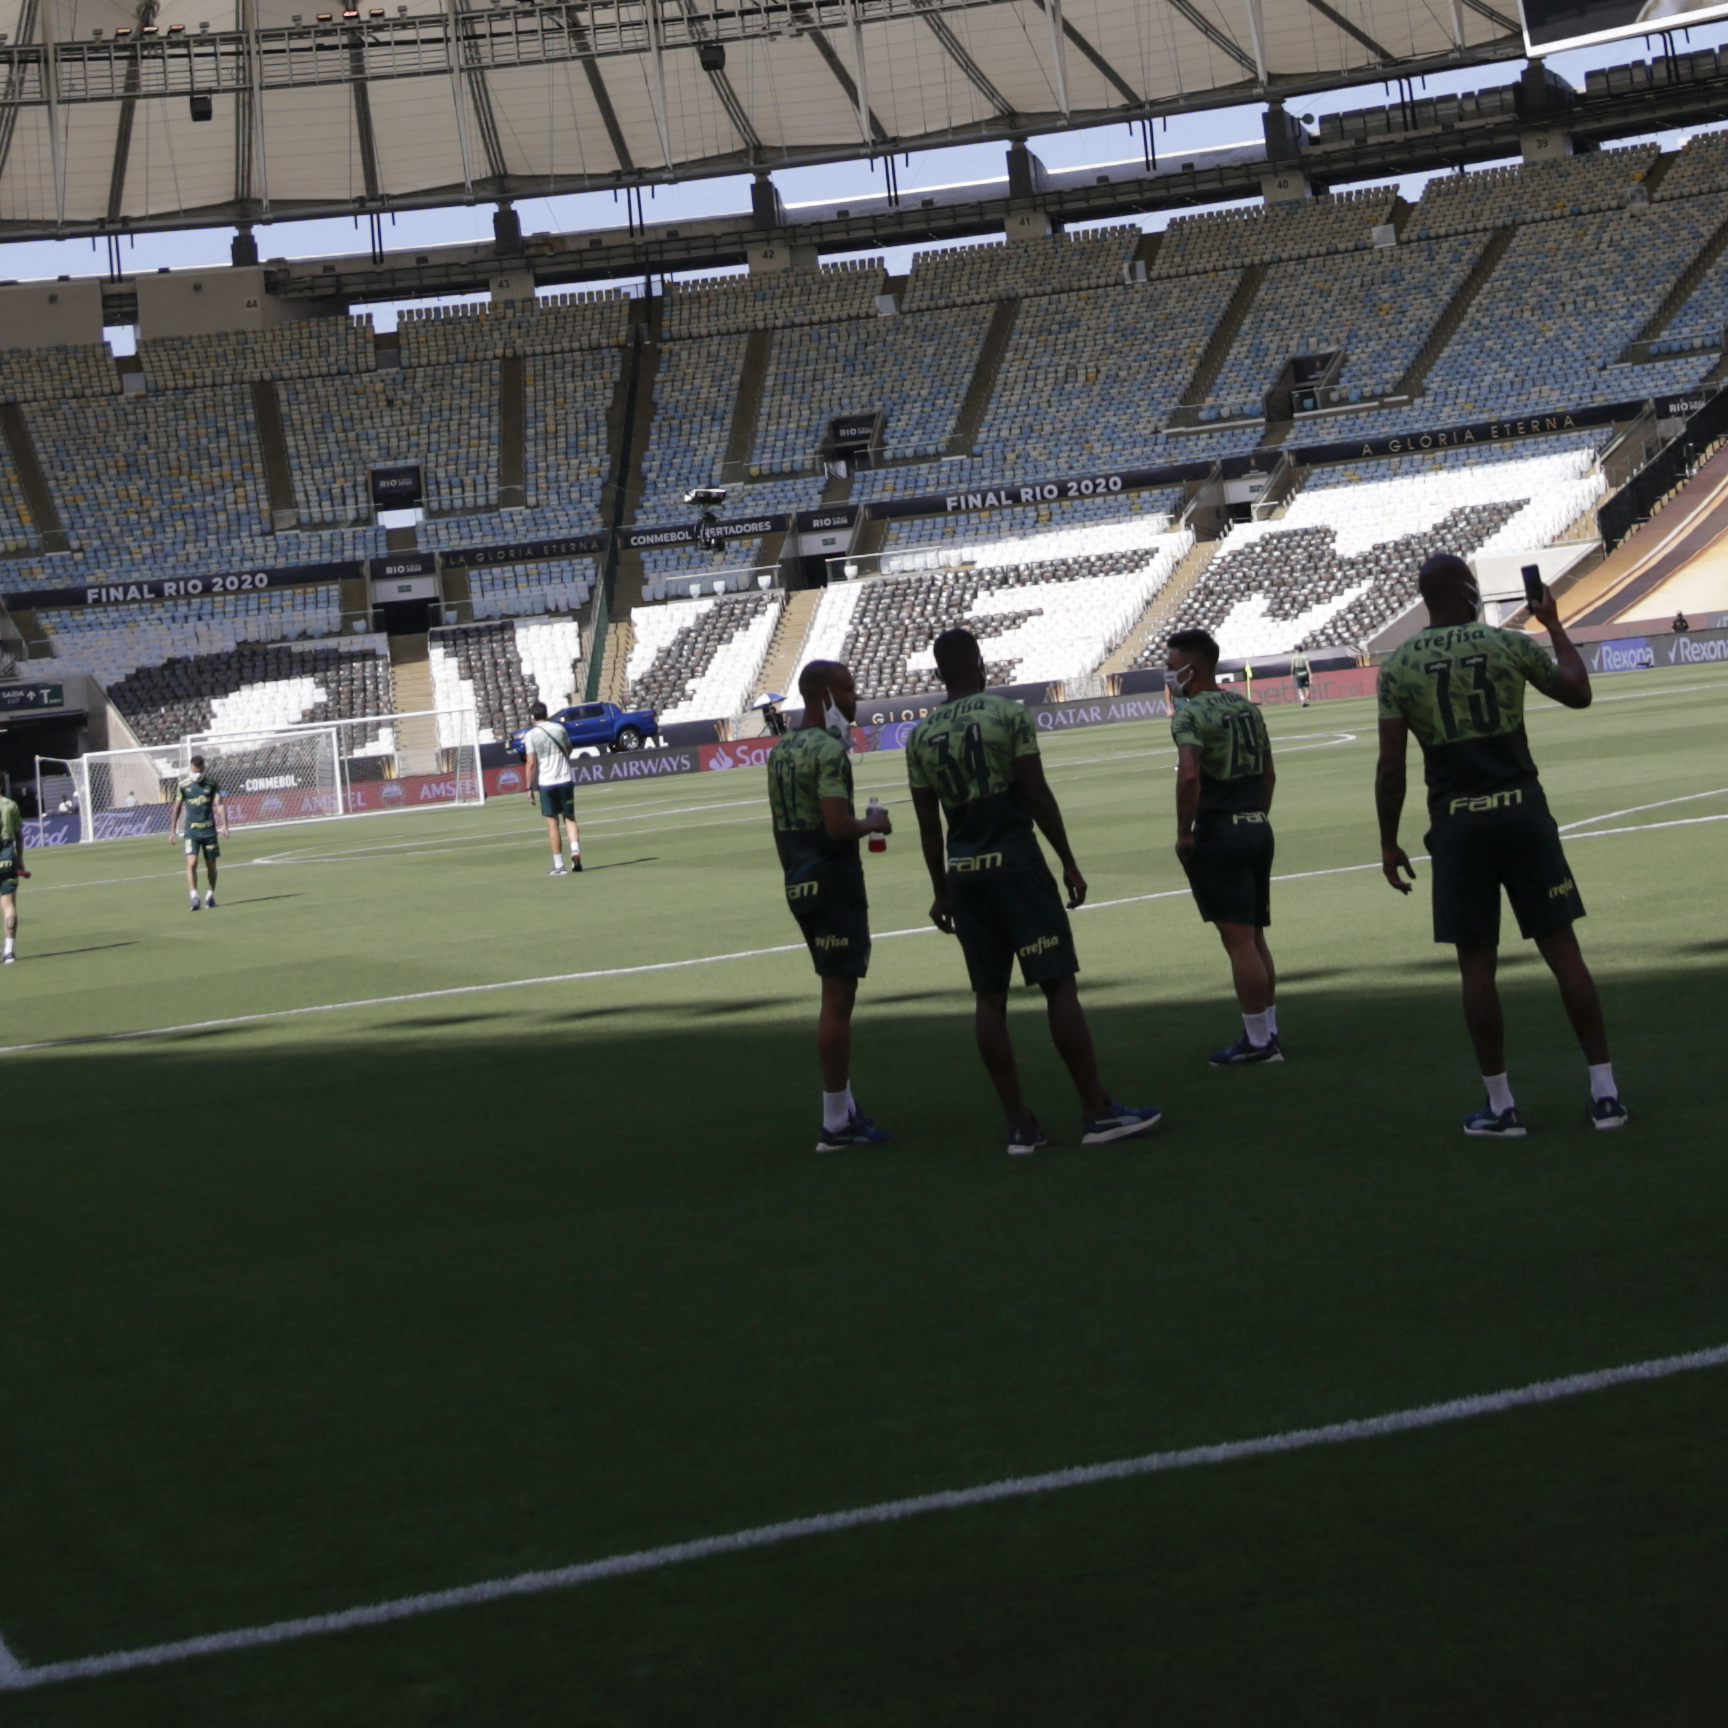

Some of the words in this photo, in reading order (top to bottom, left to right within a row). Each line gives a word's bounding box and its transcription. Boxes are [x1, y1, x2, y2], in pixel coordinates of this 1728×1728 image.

[1669, 402, 1688, 413] RIO
[839, 427, 857, 437] RIO
[1361, 443, 1374, 456] A
[1491, 415, 1576, 439] ETERNA
[379, 479, 396, 488] RIO
[946, 490, 1012, 512] FINAL
[1020, 484, 1058, 503] RIO
[1067, 476, 1122, 496] 2020
[631, 530, 692, 547] CONMEBOL
[697, 521, 771, 540] ERTADORES
[813, 517, 831, 528] RIO
[449, 554, 466, 565] LA
[543, 540, 600, 555] ETERNA
[386, 564, 406, 574] RIO
[87, 584, 155, 603] FINAL
[164, 579, 203, 596] RIO
[212, 573, 268, 591] 2020
[1414, 628, 1486, 651] crefisa
[1602, 644, 1654, 671] Rexona
[40, 689, 51, 705] T
[928, 699, 986, 725] crefisa
[1037, 705, 1101, 729] QATAR
[1107, 696, 1168, 720] AIRWA
[571, 762, 608, 783] TAR
[611, 754, 691, 779] AIRWAYS
[928, 722, 991, 803] 34
